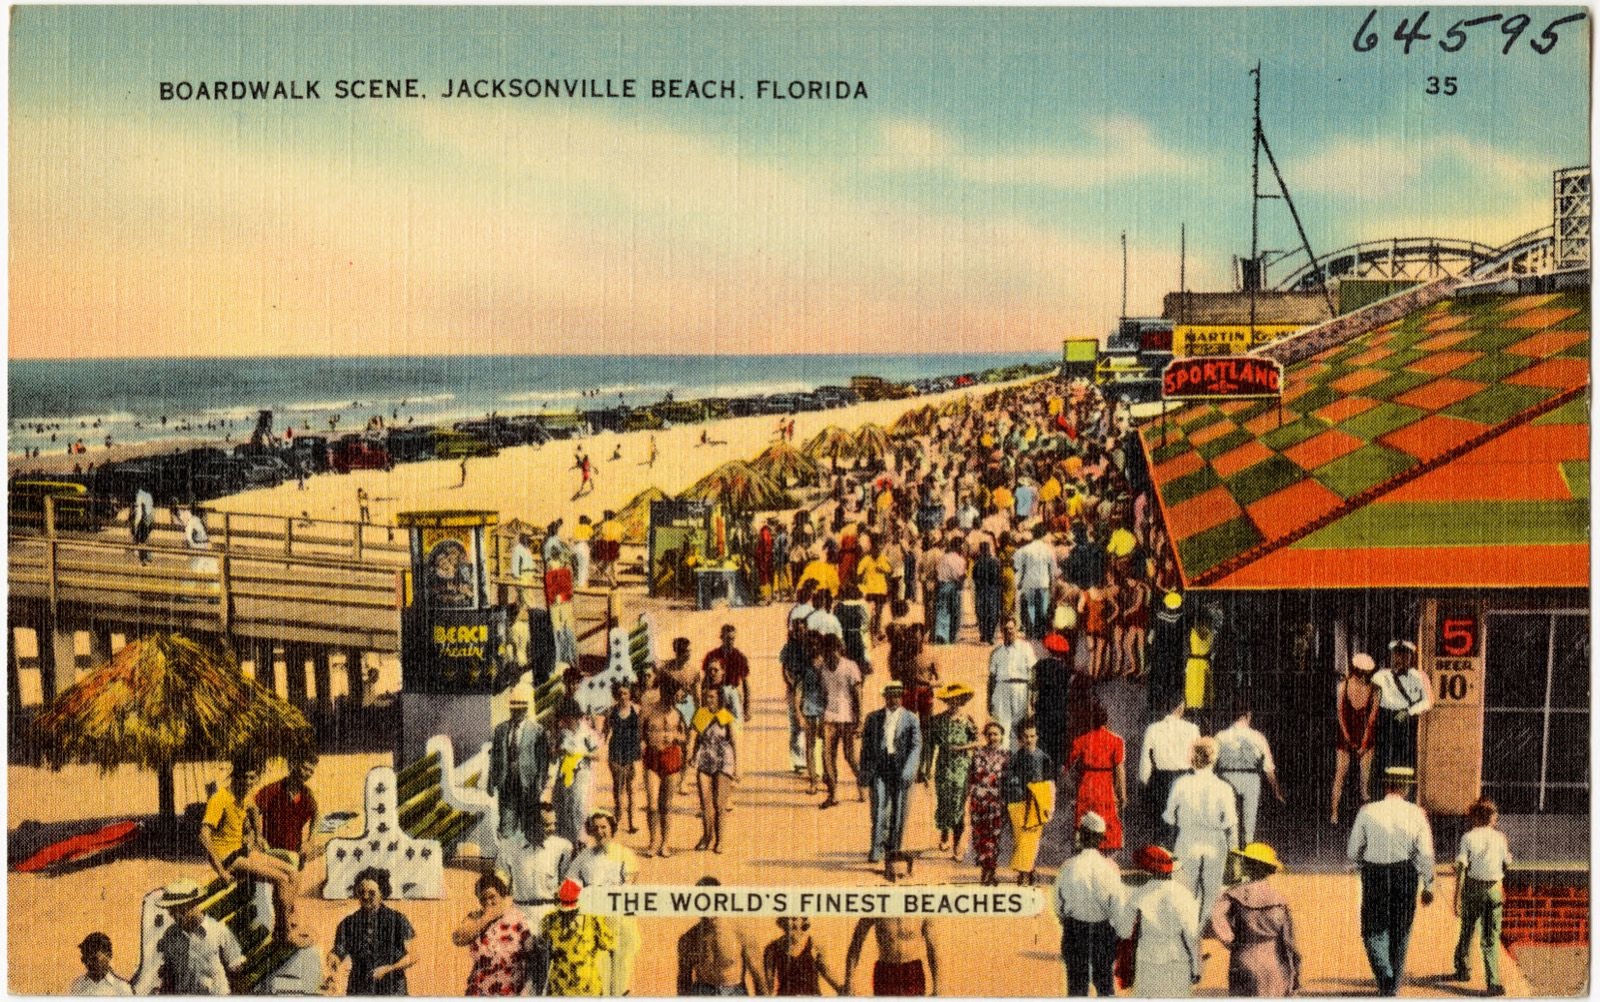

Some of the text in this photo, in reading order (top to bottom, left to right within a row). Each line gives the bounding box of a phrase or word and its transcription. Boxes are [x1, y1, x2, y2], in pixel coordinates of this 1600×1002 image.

[1352, 9, 1587, 55] 64595
[1184, 330, 1245, 342] MARTIN
[1164, 361, 1279, 393] SPORTLAND
[1443, 619, 1473, 655] 5
[1436, 659, 1472, 671] BEER
